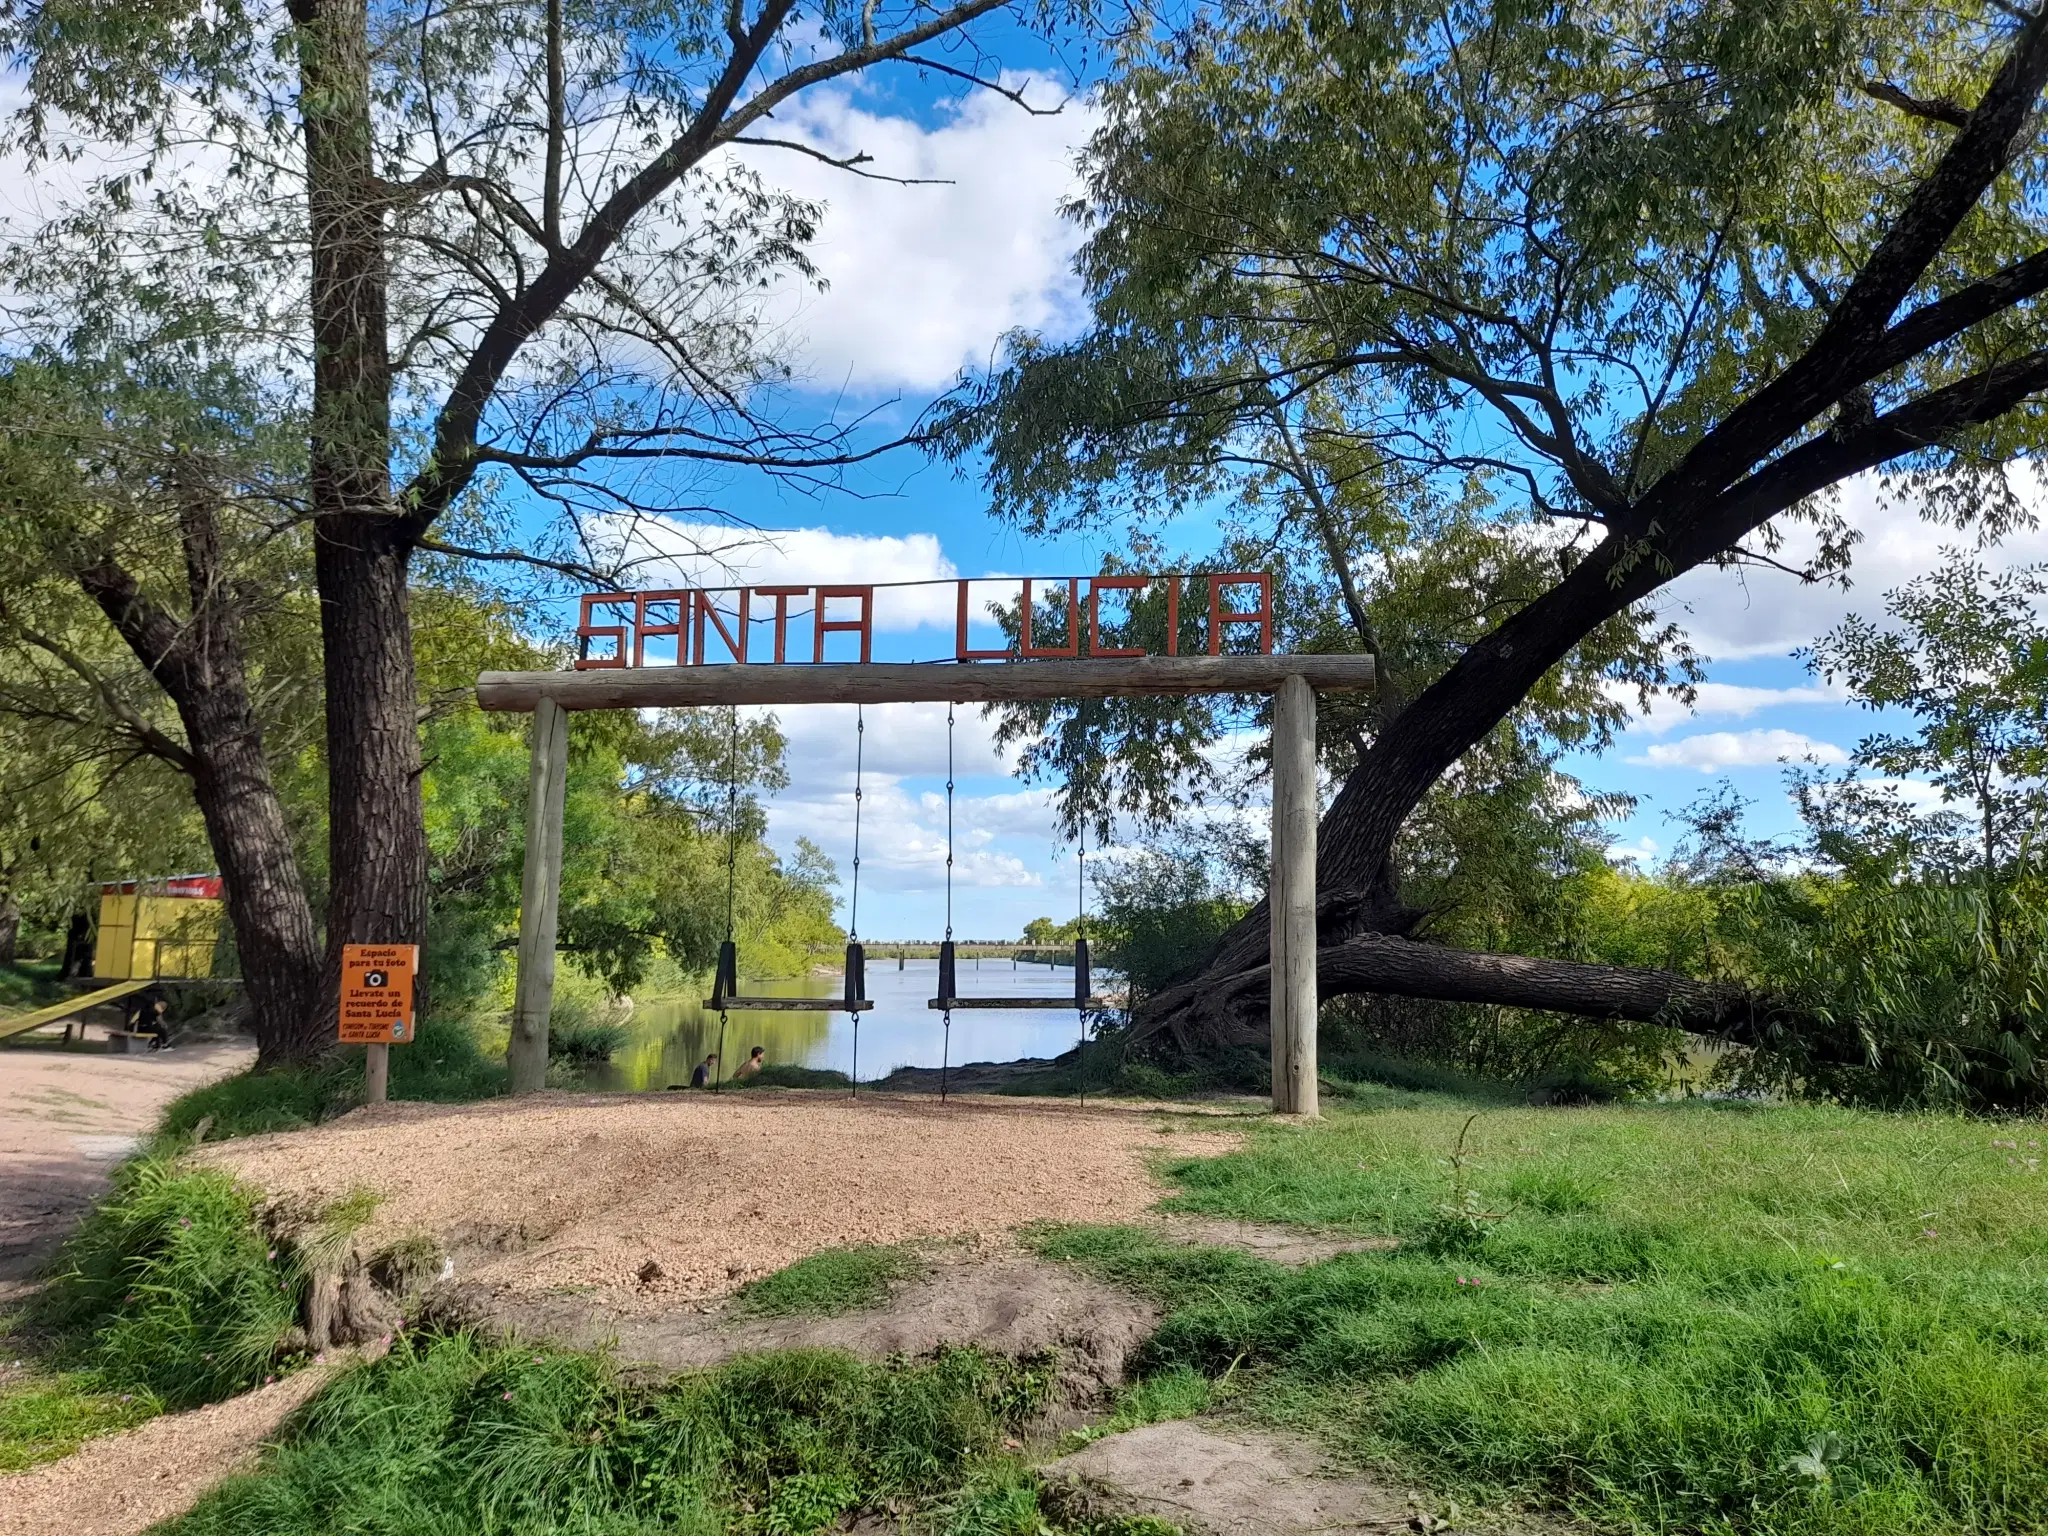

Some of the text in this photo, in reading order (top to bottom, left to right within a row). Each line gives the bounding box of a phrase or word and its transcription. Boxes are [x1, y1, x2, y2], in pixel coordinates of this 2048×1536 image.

[574, 573, 1272, 669] SANTA LUCIA
[360, 949, 396, 958] Espacio
[349, 960, 371, 968] para
[386, 959, 406, 967] foto
[375, 1009, 401, 1017] Lucía
